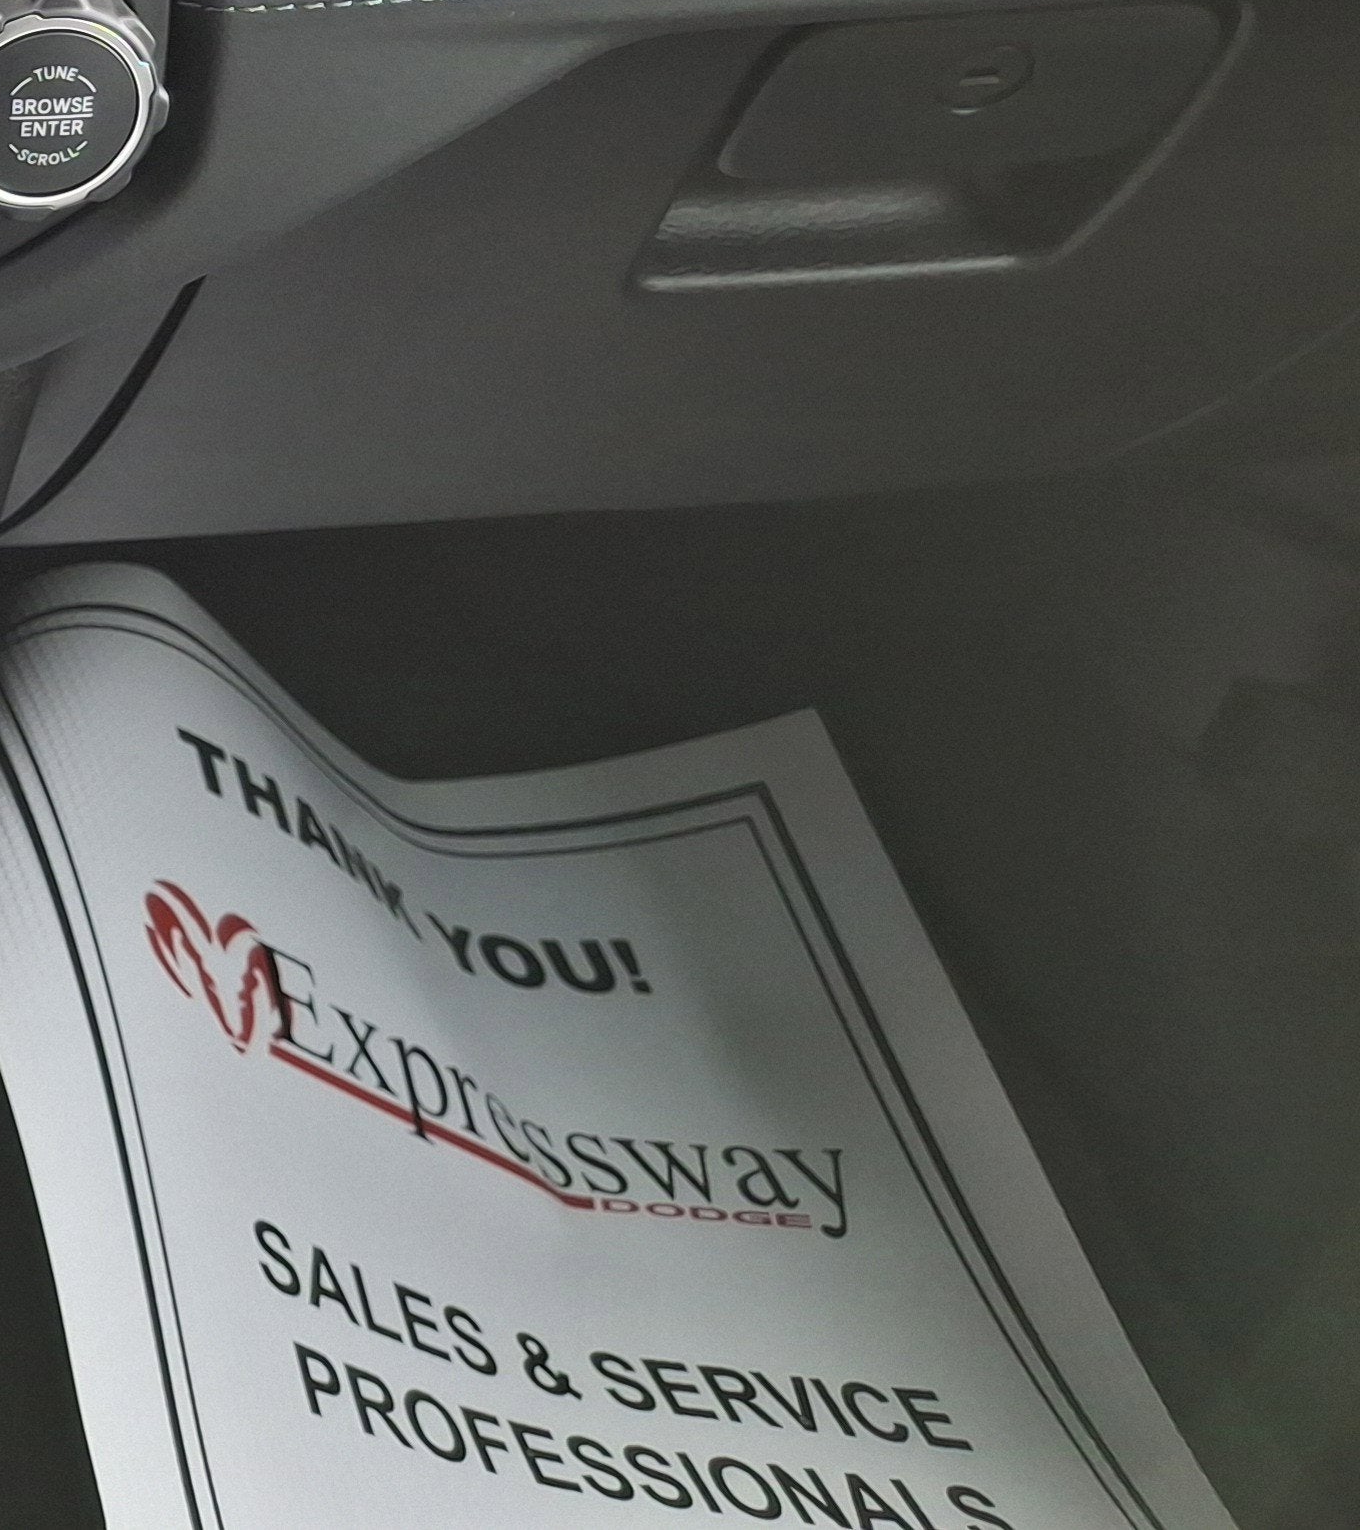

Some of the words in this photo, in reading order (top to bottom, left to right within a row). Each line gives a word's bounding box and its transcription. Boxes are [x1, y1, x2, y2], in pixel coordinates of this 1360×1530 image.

[33, 65, 79, 84] TUNE
[11, 95, 94, 117] BROWSE
[20, 119, 84, 138] ENTER
[16, 145, 81, 167] SCROLL
[178, 727, 424, 943] THANK
[427, 911, 653, 995] YOU!
[253, 940, 847, 1238] Expressway
[595, 1198, 814, 1229] DODGE
[253, 1221, 499, 1377] SALES
[517, 1331, 582, 1400] &
[590, 1351, 974, 1453] SERVICE
